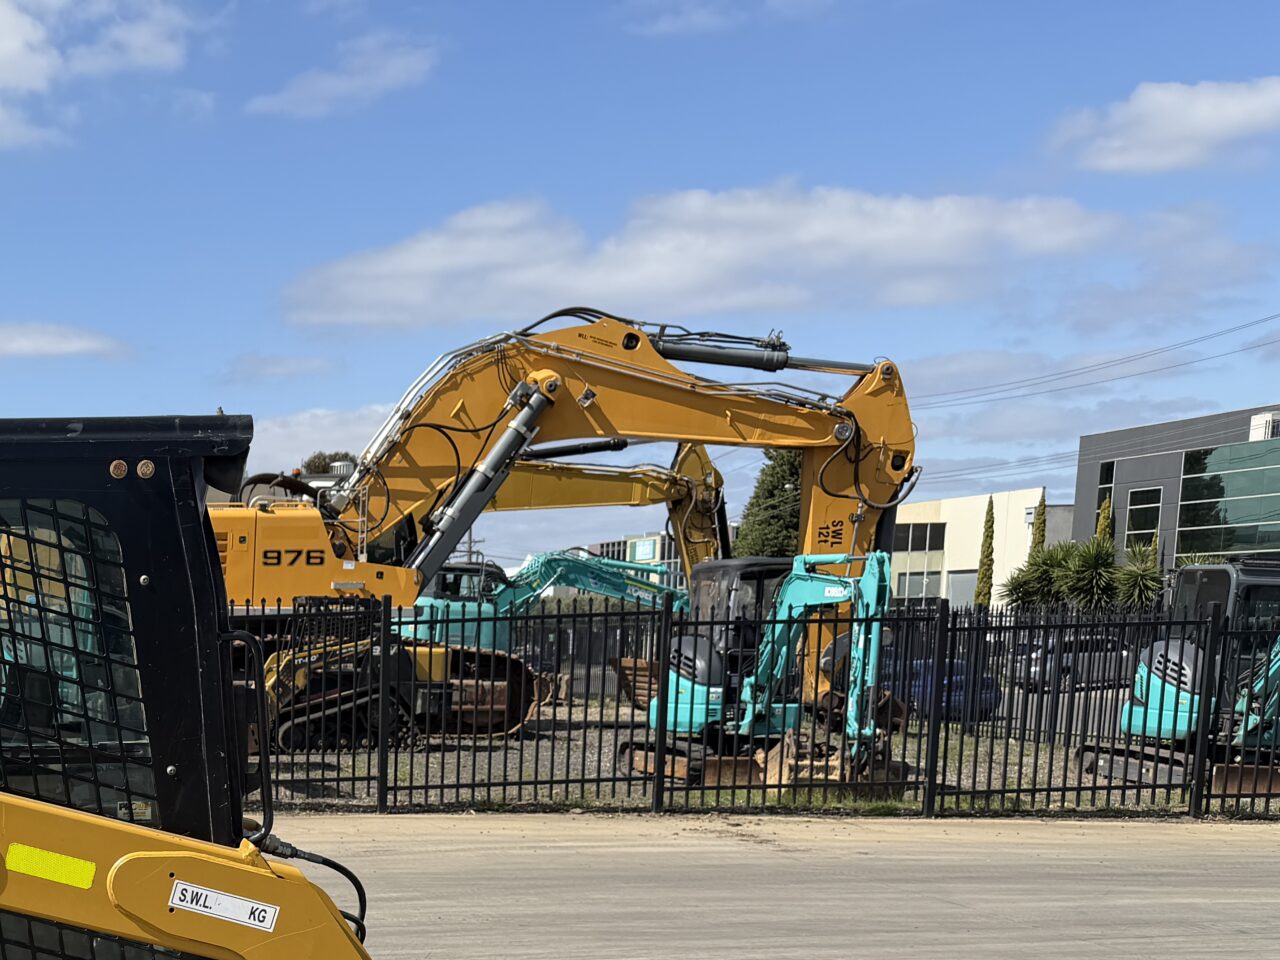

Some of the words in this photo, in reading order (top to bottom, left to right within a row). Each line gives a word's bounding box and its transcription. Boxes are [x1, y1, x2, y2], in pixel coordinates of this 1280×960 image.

[817, 524, 830, 544] 12t
[831, 520, 844, 548] SWL
[262, 549, 325, 566] 976
[178, 887, 212, 910] S.W.L.
[248, 906, 268, 923] KG
